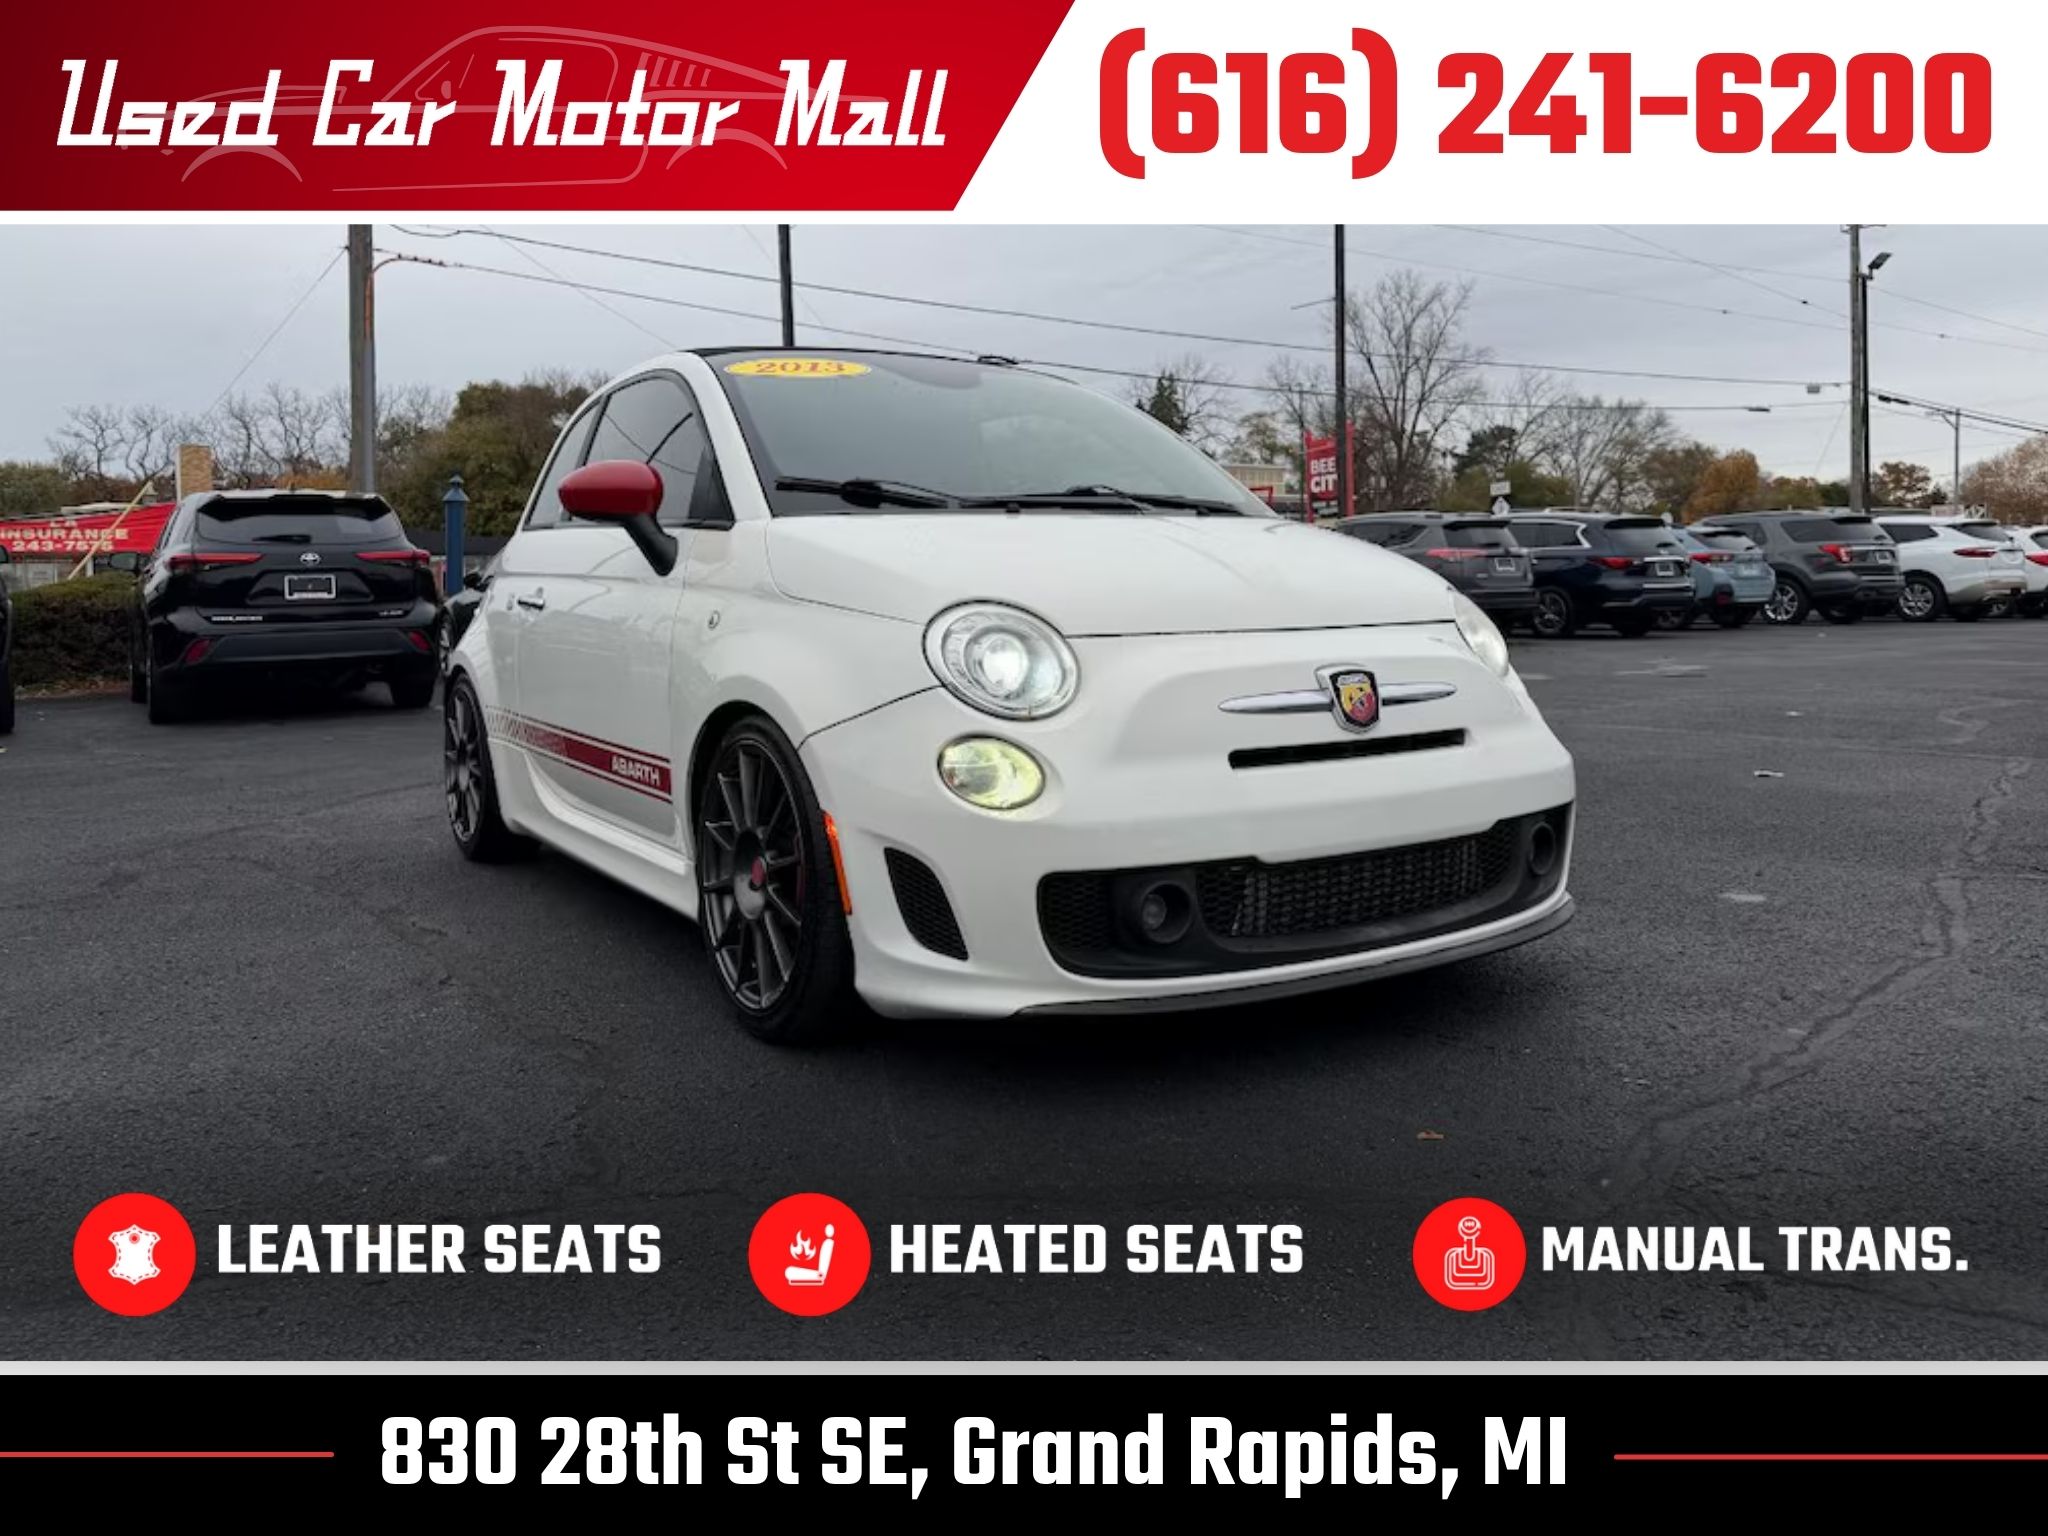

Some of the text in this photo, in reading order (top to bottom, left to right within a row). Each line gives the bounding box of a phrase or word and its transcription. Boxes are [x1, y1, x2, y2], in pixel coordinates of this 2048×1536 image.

[756, 361, 845, 374] 2013
[1311, 457, 1337, 475] BEE
[1311, 474, 1338, 493] CIT
[0, 528, 129, 540] INSURANCE
[611, 756, 661, 786] ABARTH
